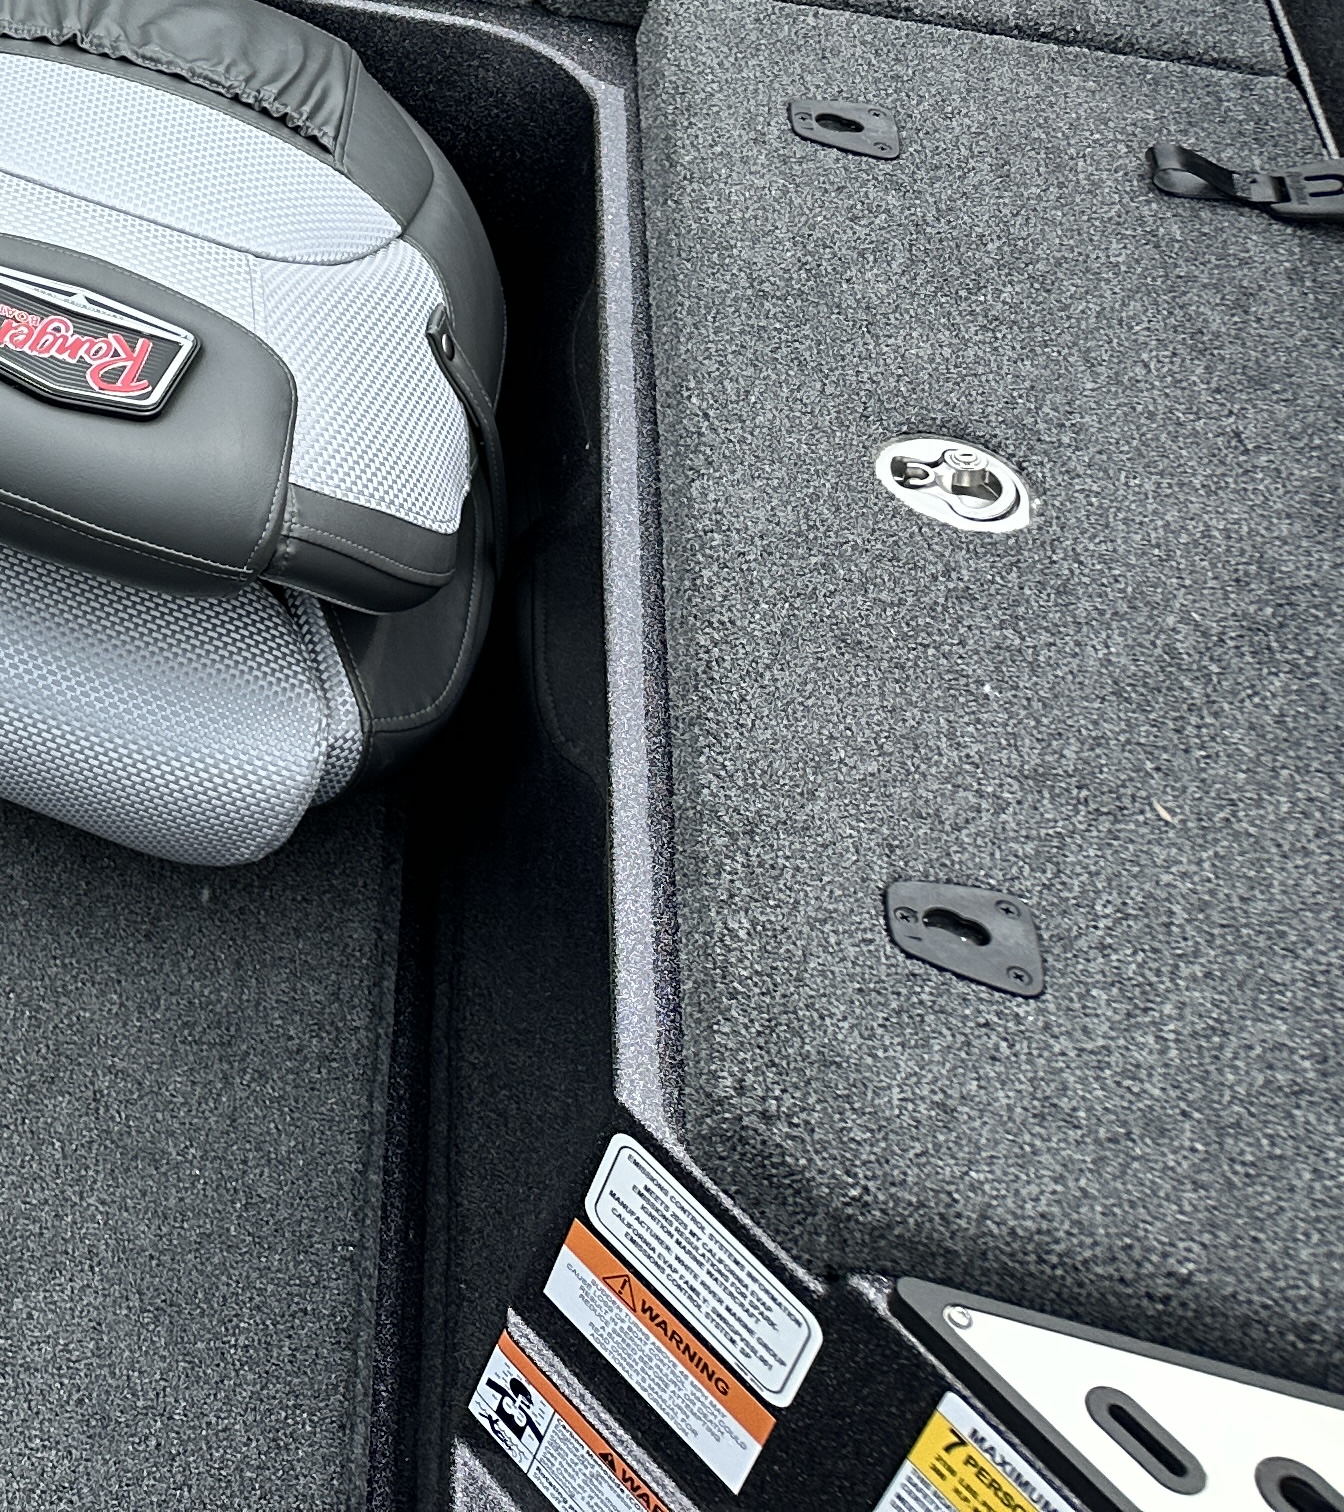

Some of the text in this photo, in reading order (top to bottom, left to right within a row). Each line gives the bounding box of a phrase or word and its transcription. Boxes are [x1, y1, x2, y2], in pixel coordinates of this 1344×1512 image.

[626, 1153, 669, 1198] EMISSIONS
[668, 1194, 707, 1236] CONTROL
[638, 1298, 731, 1398] WARNING
[555, 1416, 585, 1451] Carbon
[585, 1448, 626, 1494] Monoxide
[938, 1426, 969, 1462] 7
